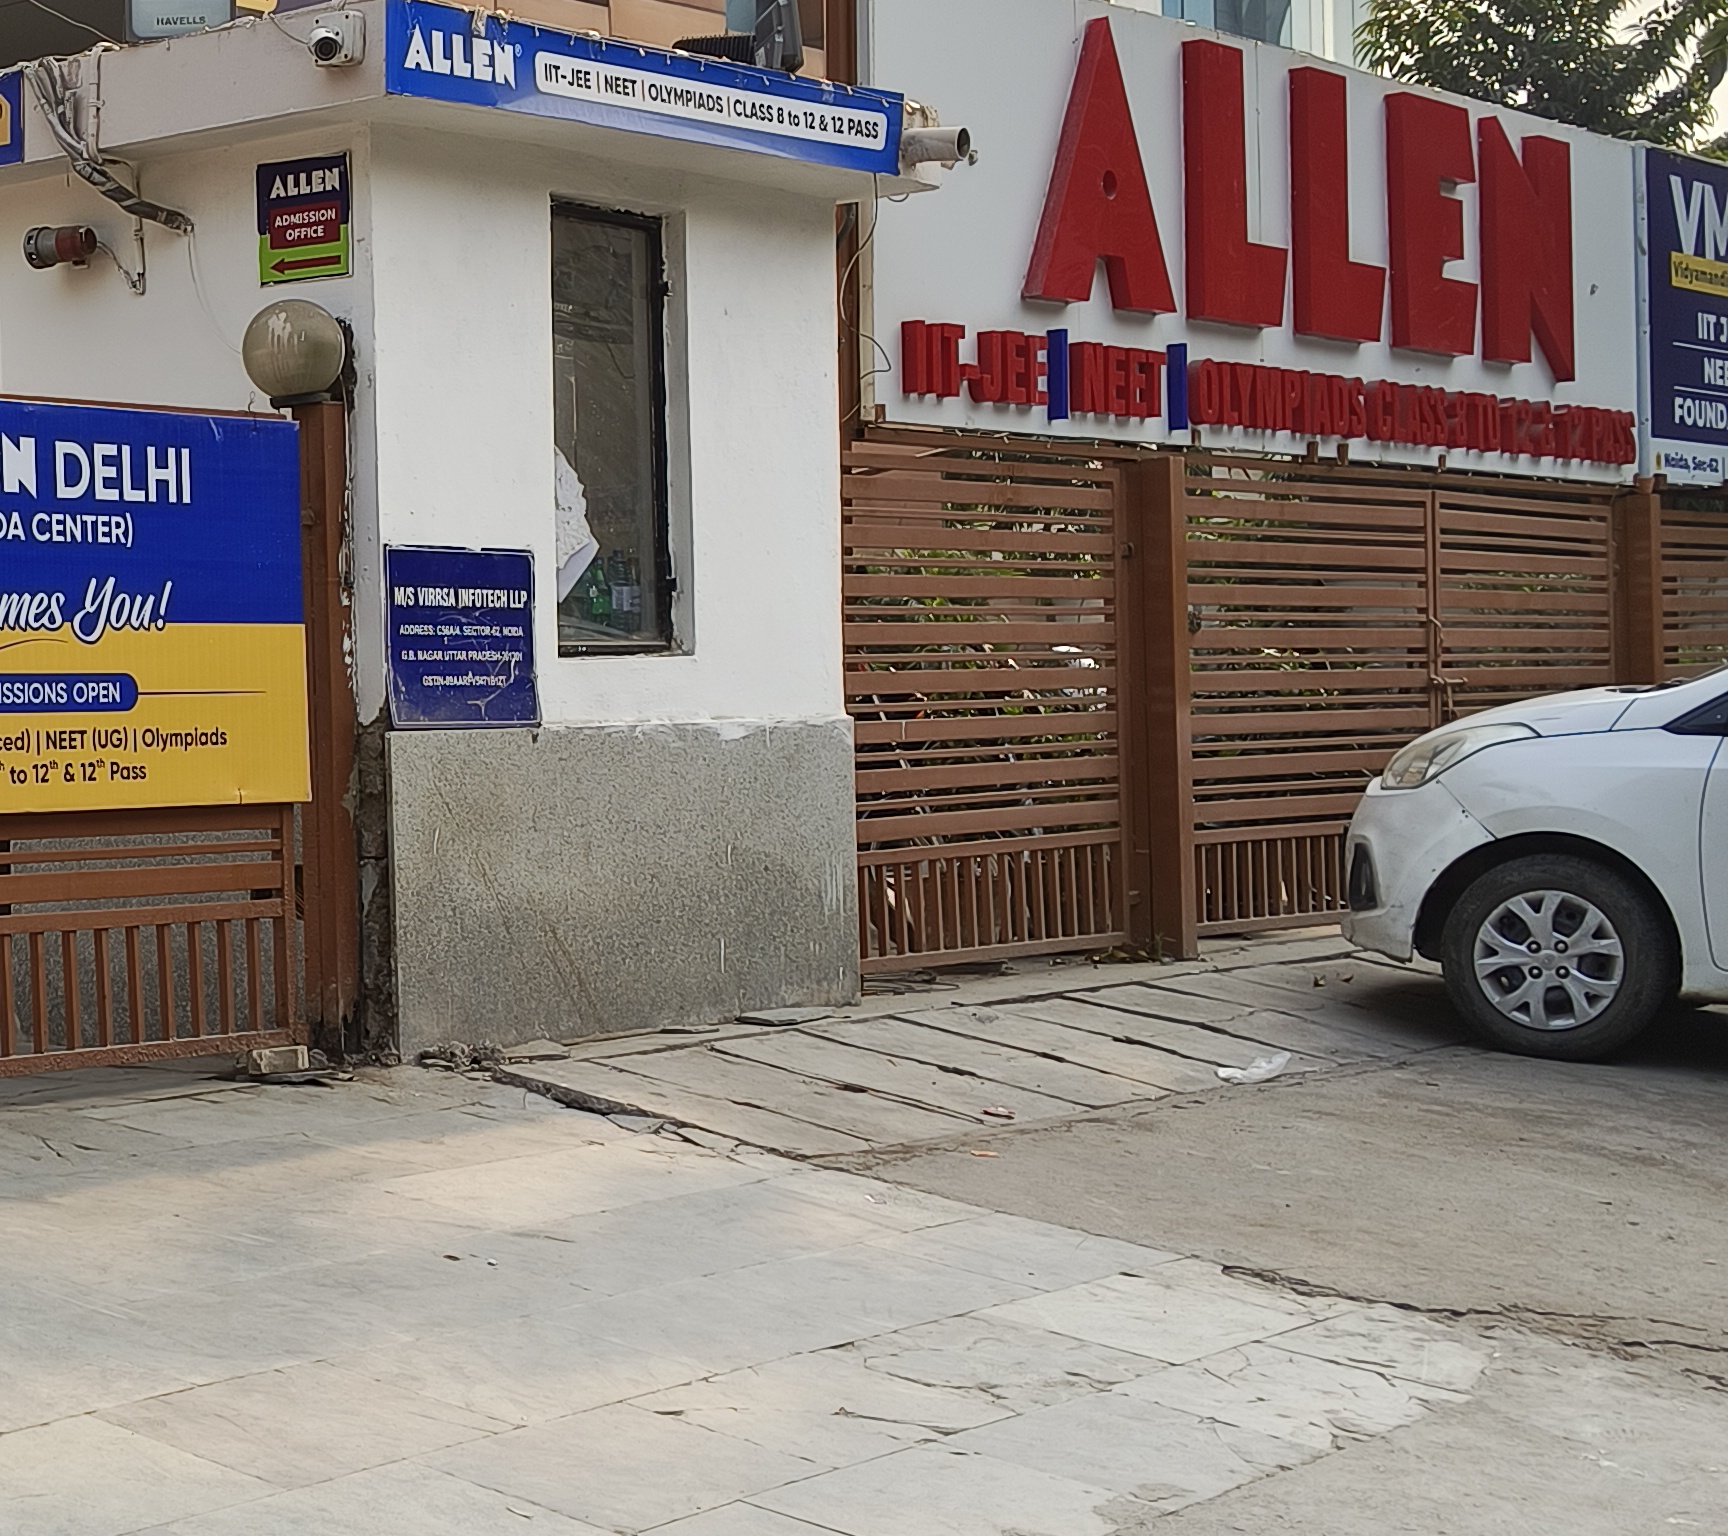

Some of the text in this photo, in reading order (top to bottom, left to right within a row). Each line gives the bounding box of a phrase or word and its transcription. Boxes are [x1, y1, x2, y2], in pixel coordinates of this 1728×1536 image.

[156, 15, 206, 26] HAVELLS
[544, 63, 592, 90] IIT-JEE
[604, 74, 638, 98] NEET
[648, 83, 724, 114] OLYMPIADS
[733, 99, 774, 124] CLASS
[777, 108, 784, 124] 8
[787, 110, 801, 128] to
[803, 112, 816, 130] 12
[818, 116, 828, 132] &
[831, 117, 844, 134] 12
[847, 119, 879, 140] PASS
[269, 167, 340, 200] ALLEN
[1022, 15, 1576, 383] ALLEN
[274, 207, 336, 228] ADMISSION
[285, 225, 325, 242] OFFICE
[1697, 311, 1717, 342] IIT
[901, 319, 1048, 406] IIT-JEE
[1068, 341, 1168, 418] NEET
[1187, 358, 1366, 439] OLYMPIADS
[1366, 378, 1450, 448] CLASS
[1467, 392, 1501, 452] TO
[1500, 397, 1532, 456] 12
[1556, 404, 1584, 460] 12
[1584, 407, 1637, 465] PASS
[1674, 396, 1728, 431] FOUND
[55, 440, 191, 504] DELHI
[31, 512, 134, 548] CENTER)
[73, 576, 173, 643] You!
[394, 586, 528, 609] M/S VIRRSA INFOTECH LLP
[399, 624, 436, 636] ADDRESS:
[444, 650, 467, 661] UTTAR
[72, 681, 121, 704] OPEN
[46, 730, 88, 751] NEET
[92, 727, 129, 752] (UG)
[141, 727, 228, 753] Olympiads
[9, 766, 28, 785] to
[63, 765, 75, 783] &
[110, 762, 148, 781] Pass
